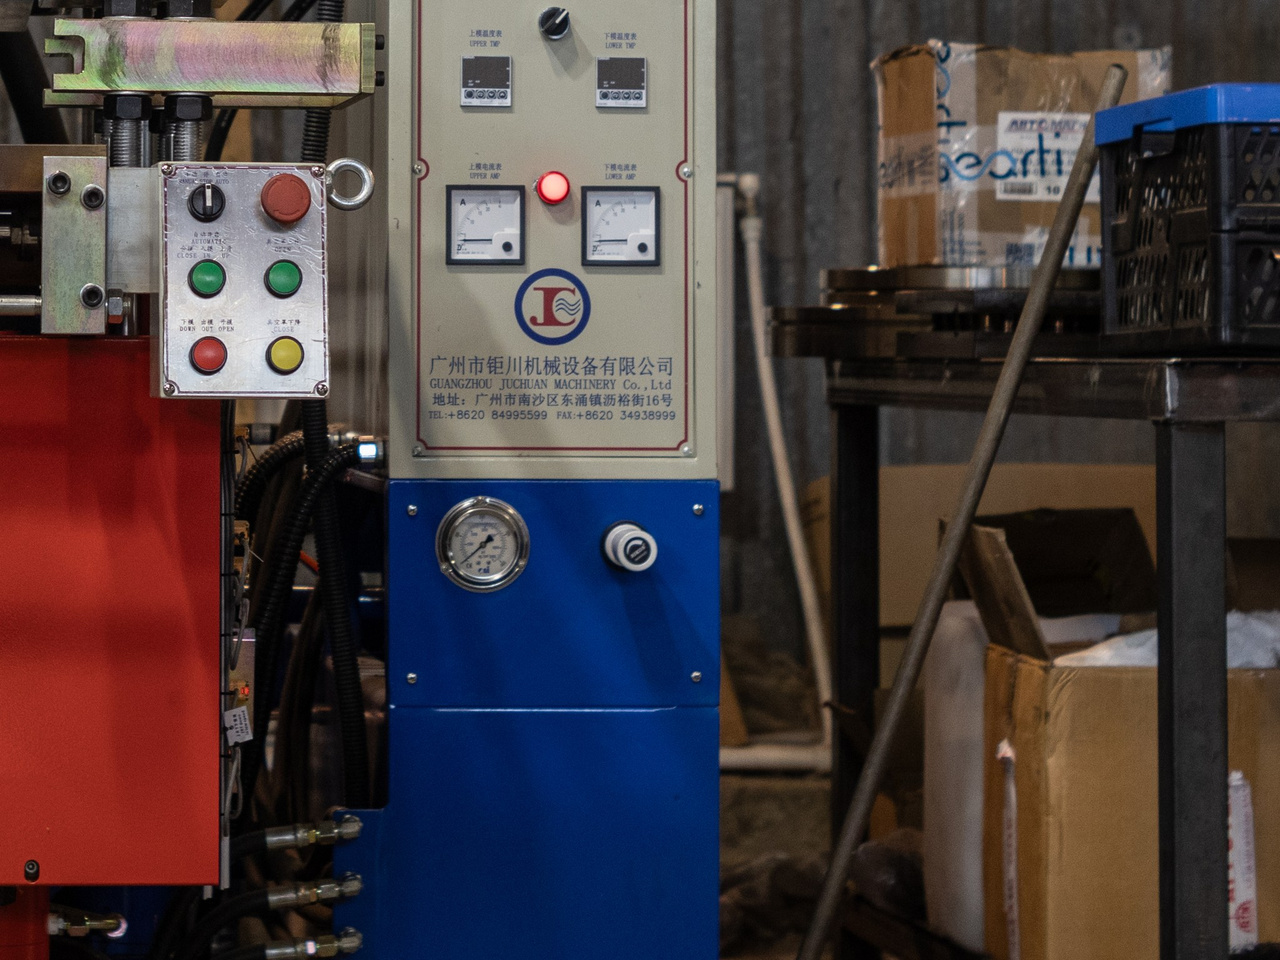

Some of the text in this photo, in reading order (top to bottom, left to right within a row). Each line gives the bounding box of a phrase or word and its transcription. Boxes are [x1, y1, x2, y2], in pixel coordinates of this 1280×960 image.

[460, 198, 466, 206] A
[429, 355, 673, 376] 广州市钜川机械设备有限公司
[430, 378, 672, 391] GUANGZHOU JUCHUAN MACHINERY Co.,Ltd
[429, 410, 676, 420] TEL:+8620 84995599 FAX:+8620 34938999
